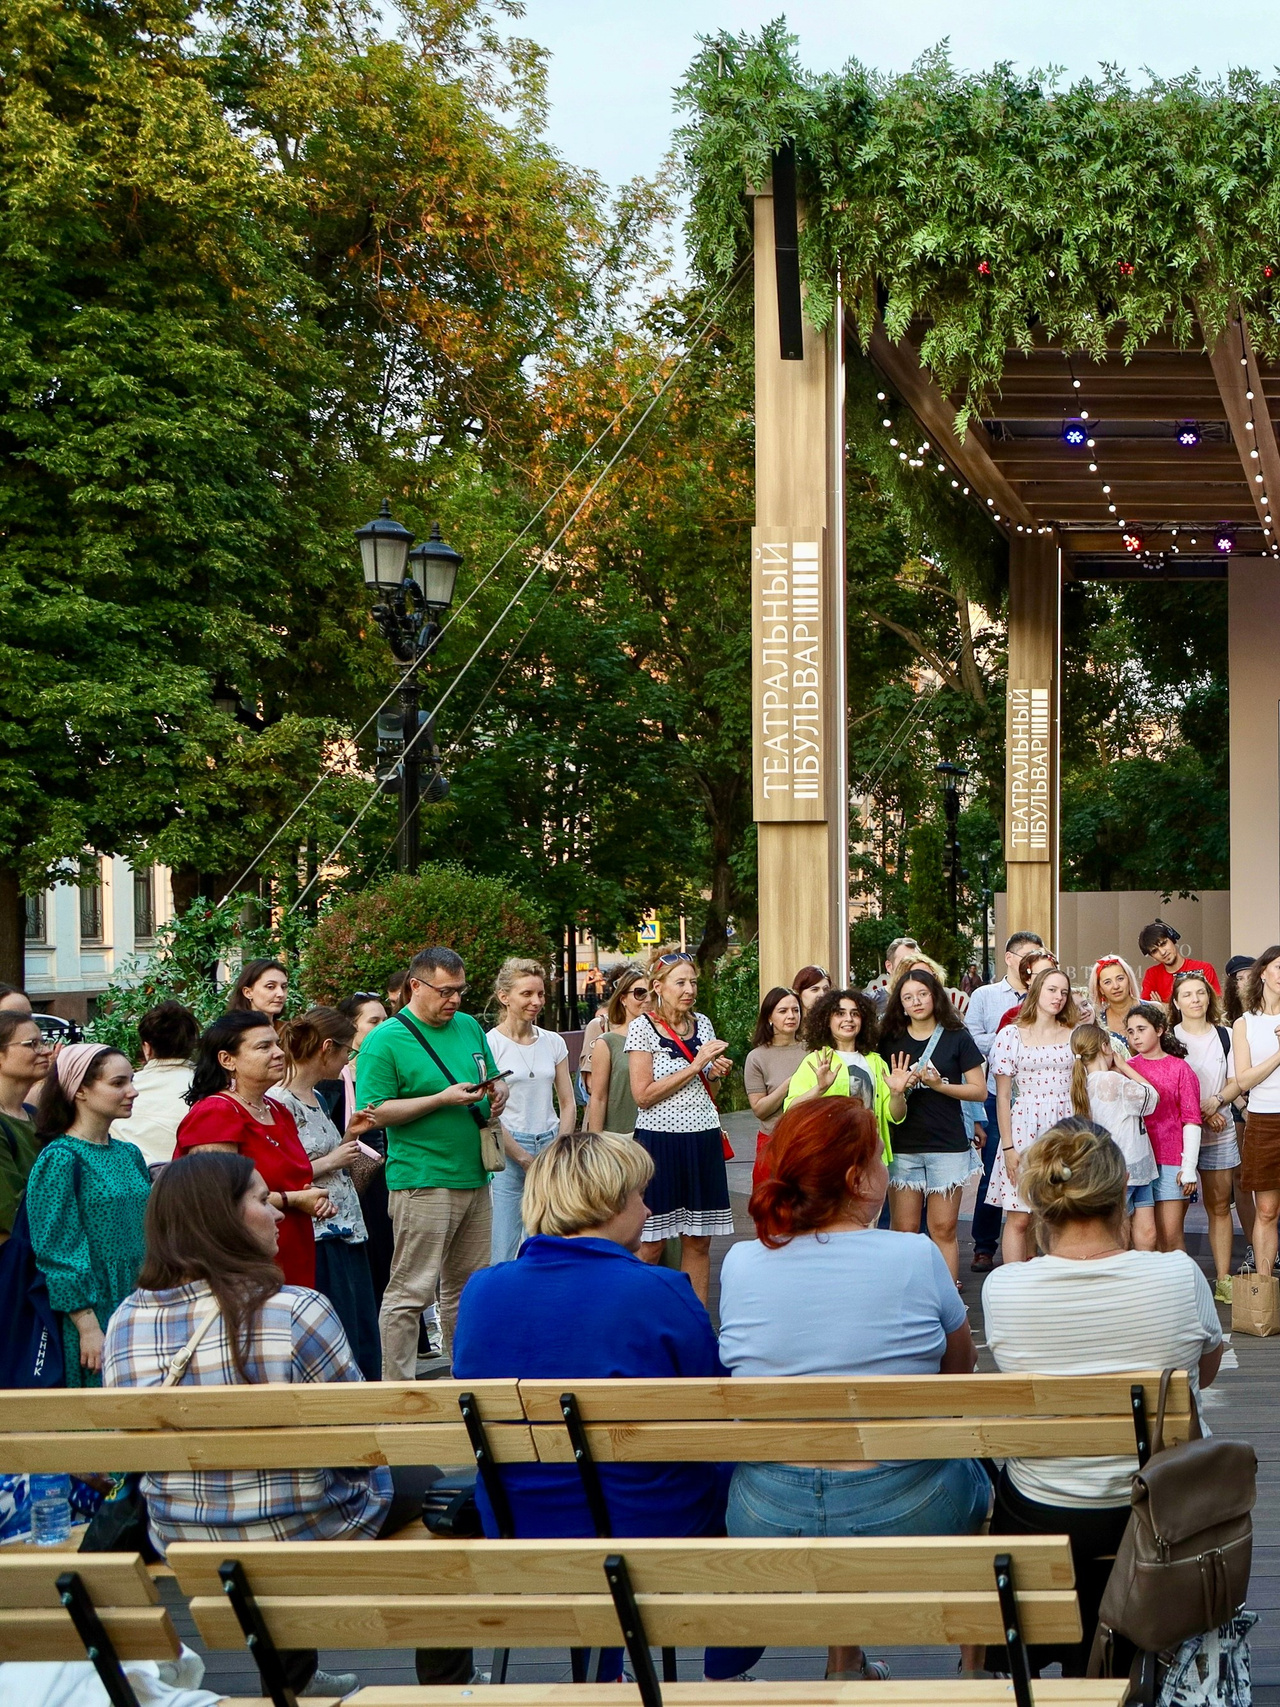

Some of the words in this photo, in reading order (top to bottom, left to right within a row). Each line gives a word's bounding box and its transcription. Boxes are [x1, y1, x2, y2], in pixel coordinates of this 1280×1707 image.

[755, 542, 790, 799] ТЕАТРАЛЬНЫЙ
[792, 623, 820, 775] БУЛЬВАР
[1008, 688, 1030, 848] ТЕАТРАЛЬНЫЙ
[1030, 739, 1048, 833] БУЛЬВАР
[34, 1326, 48, 1376] ЕННИК
